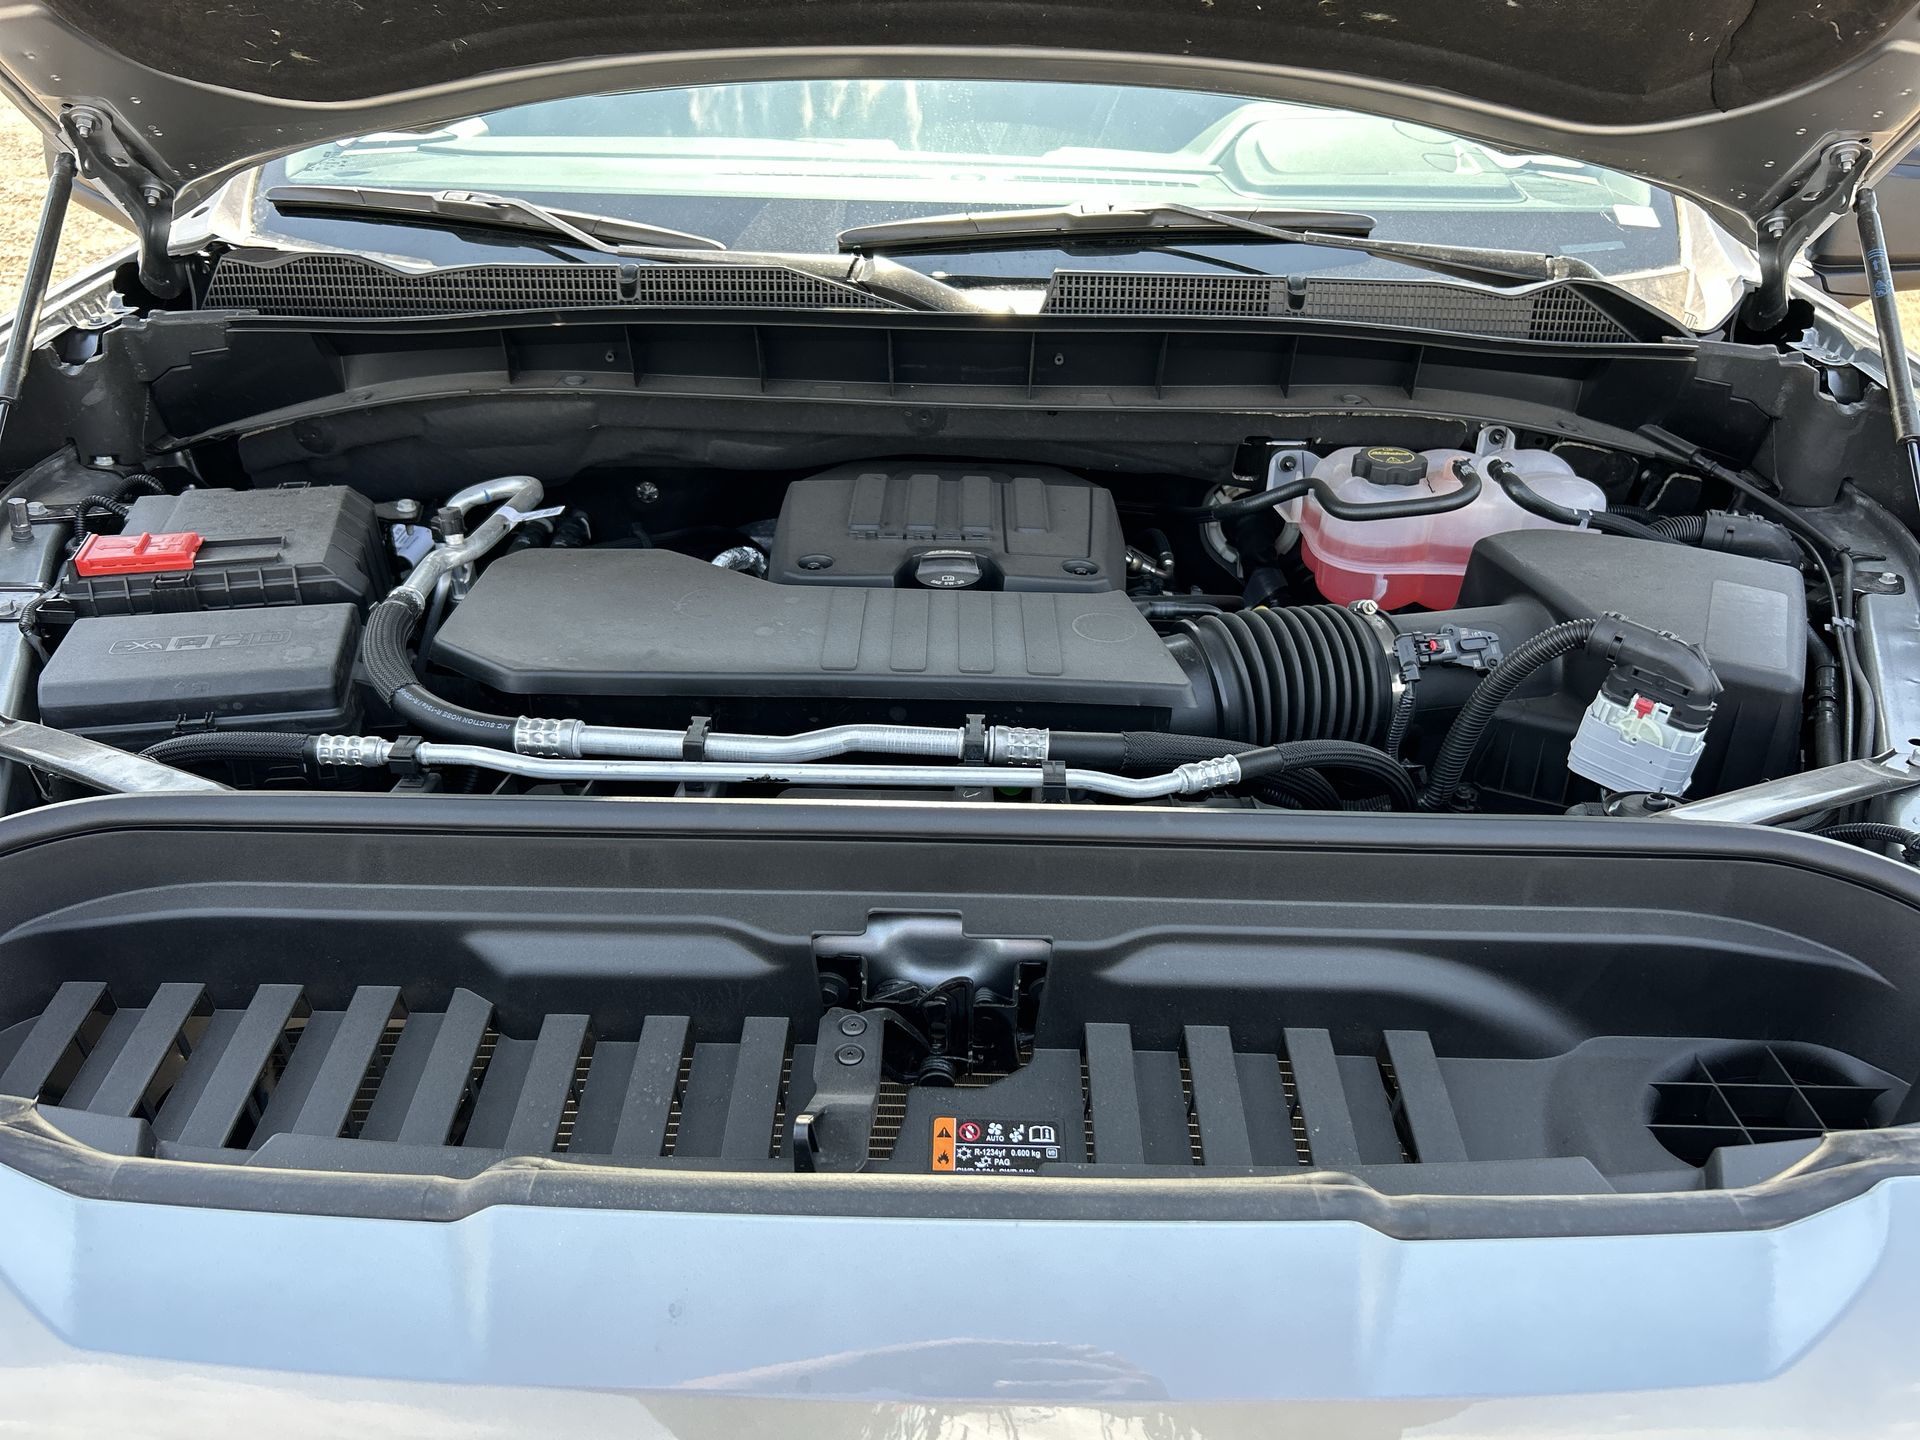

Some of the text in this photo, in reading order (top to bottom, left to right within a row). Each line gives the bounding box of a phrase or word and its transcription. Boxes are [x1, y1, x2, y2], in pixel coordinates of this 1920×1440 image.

[442, 712, 462, 721] HOSE
[463, 719, 496, 728] SUCTION
[974, 1148, 1007, 1157] R-1234yf
[1011, 1149, 1031, 1157] 0.600
[1032, 1149, 1041, 1158] kg
[994, 1158, 1011, 1166] PAG
